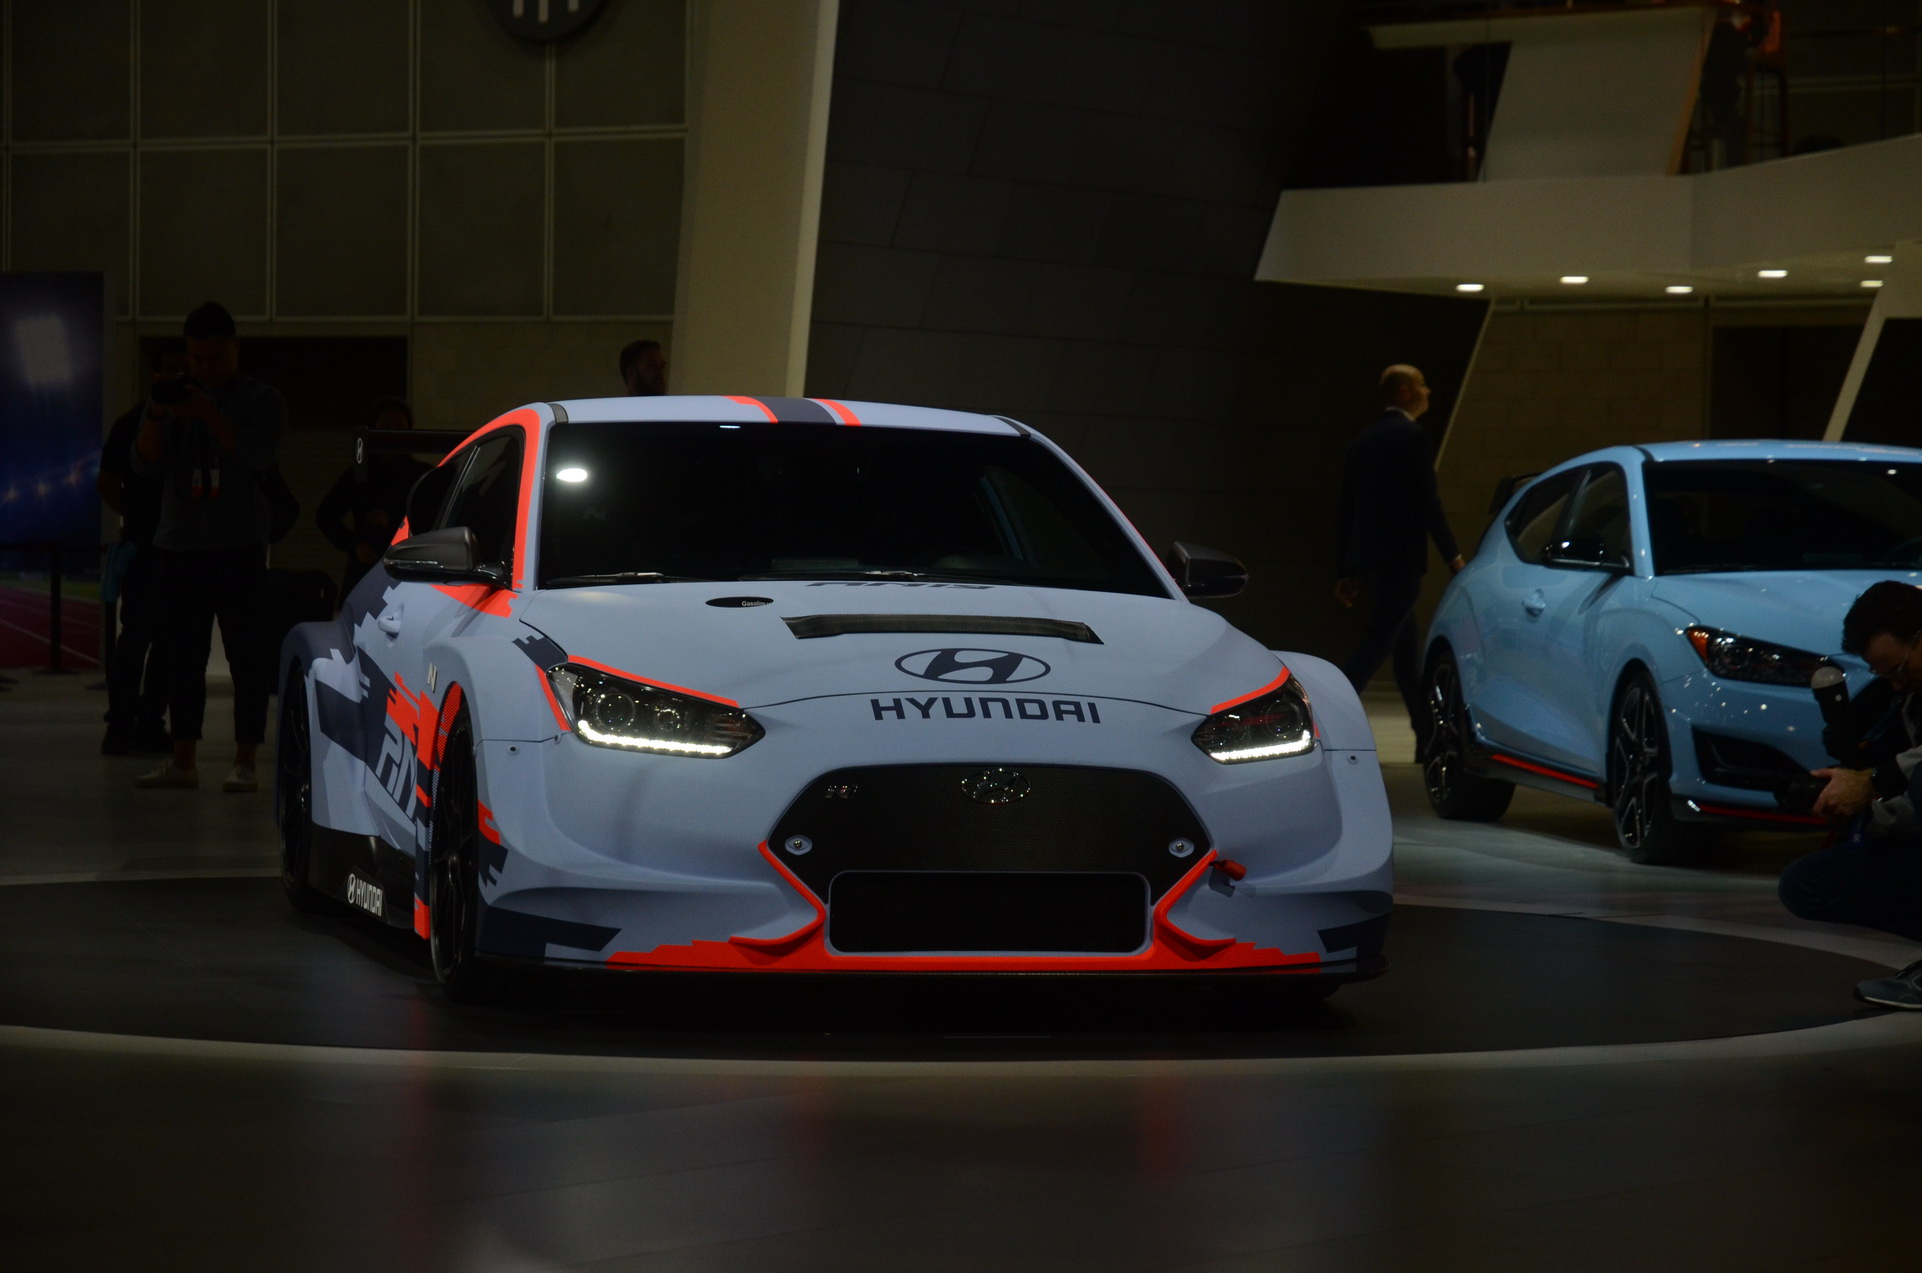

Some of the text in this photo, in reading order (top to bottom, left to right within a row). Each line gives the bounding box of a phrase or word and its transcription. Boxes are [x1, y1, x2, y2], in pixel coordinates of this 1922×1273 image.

[427, 661, 437, 693] N
[870, 697, 1101, 724] HYUNDAI
[355, 877, 383, 917] HYUNDAI
